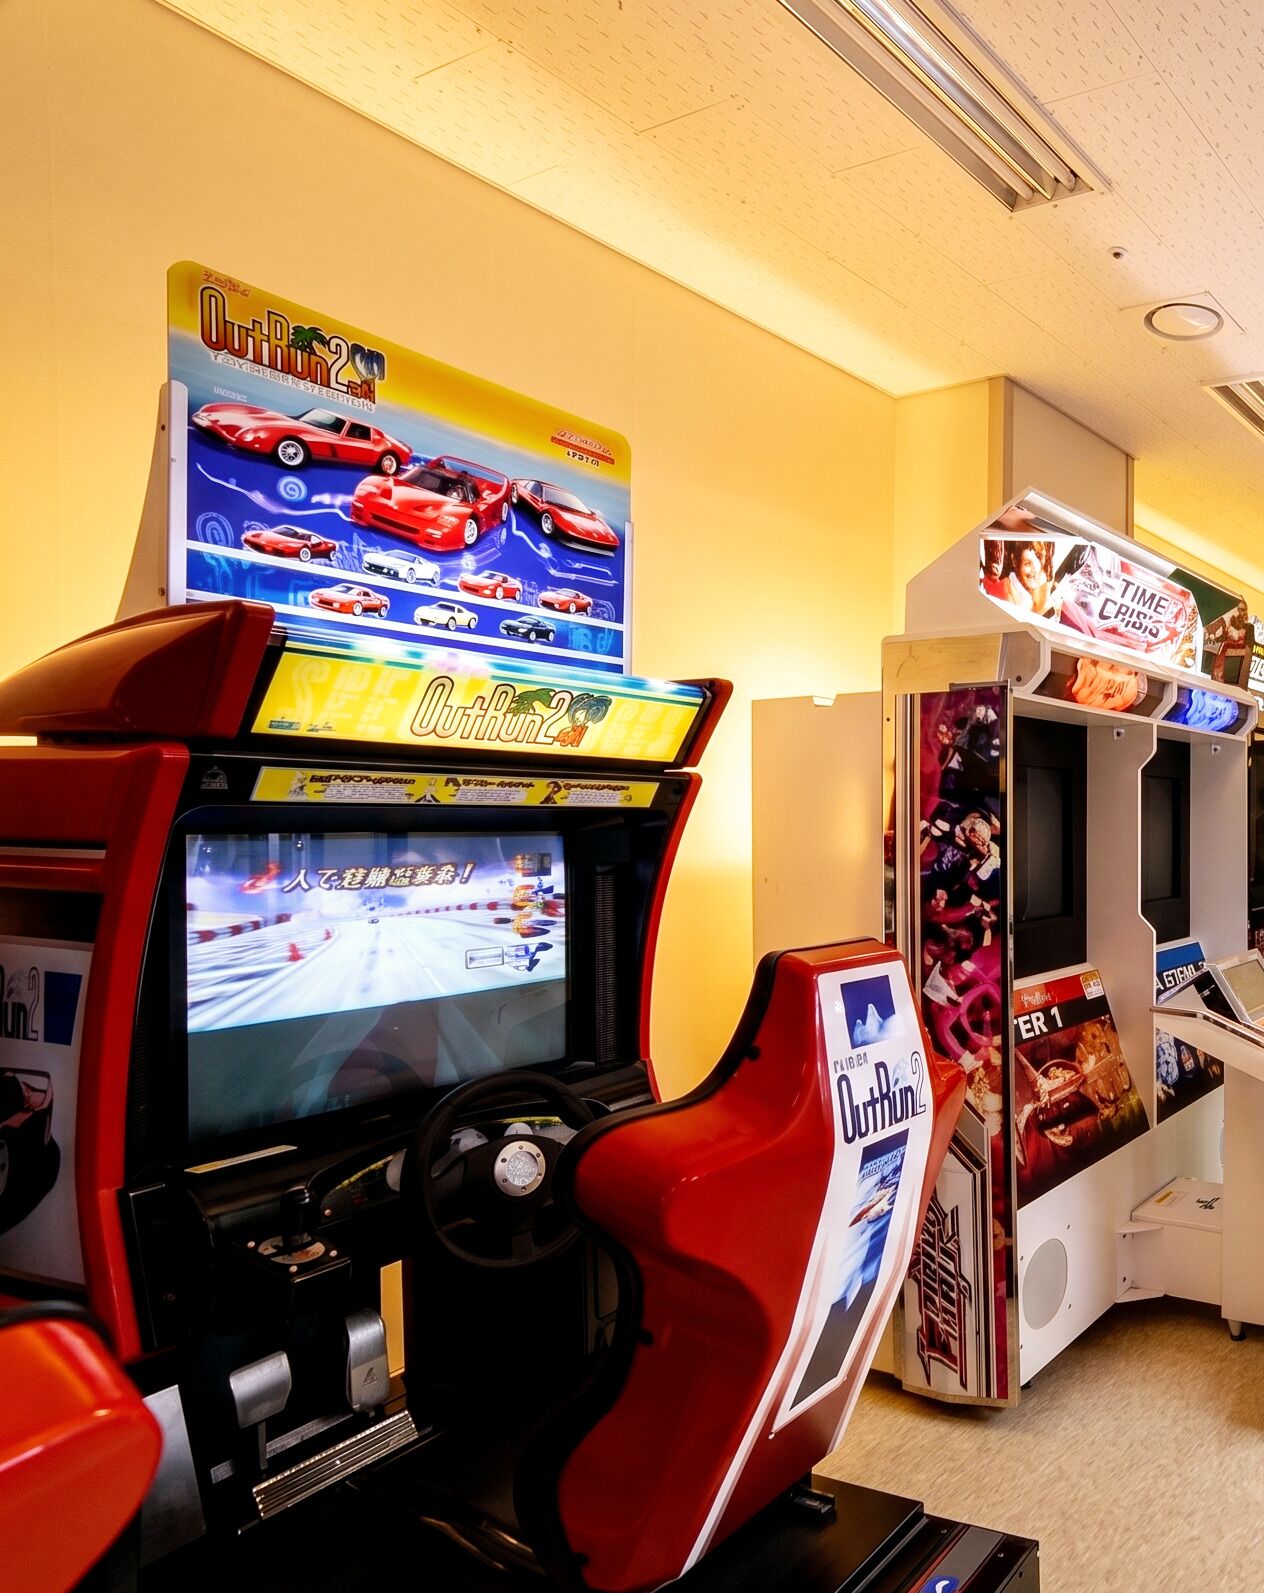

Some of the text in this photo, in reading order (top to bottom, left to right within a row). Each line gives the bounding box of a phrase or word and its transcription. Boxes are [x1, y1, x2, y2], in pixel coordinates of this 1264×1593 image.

[1120, 578, 1170, 616] TIME
[1098, 597, 1161, 639] CRISIS
[1013, 1005, 1063, 1040] ER 1
[836, 1050, 927, 1145] OutRun2
